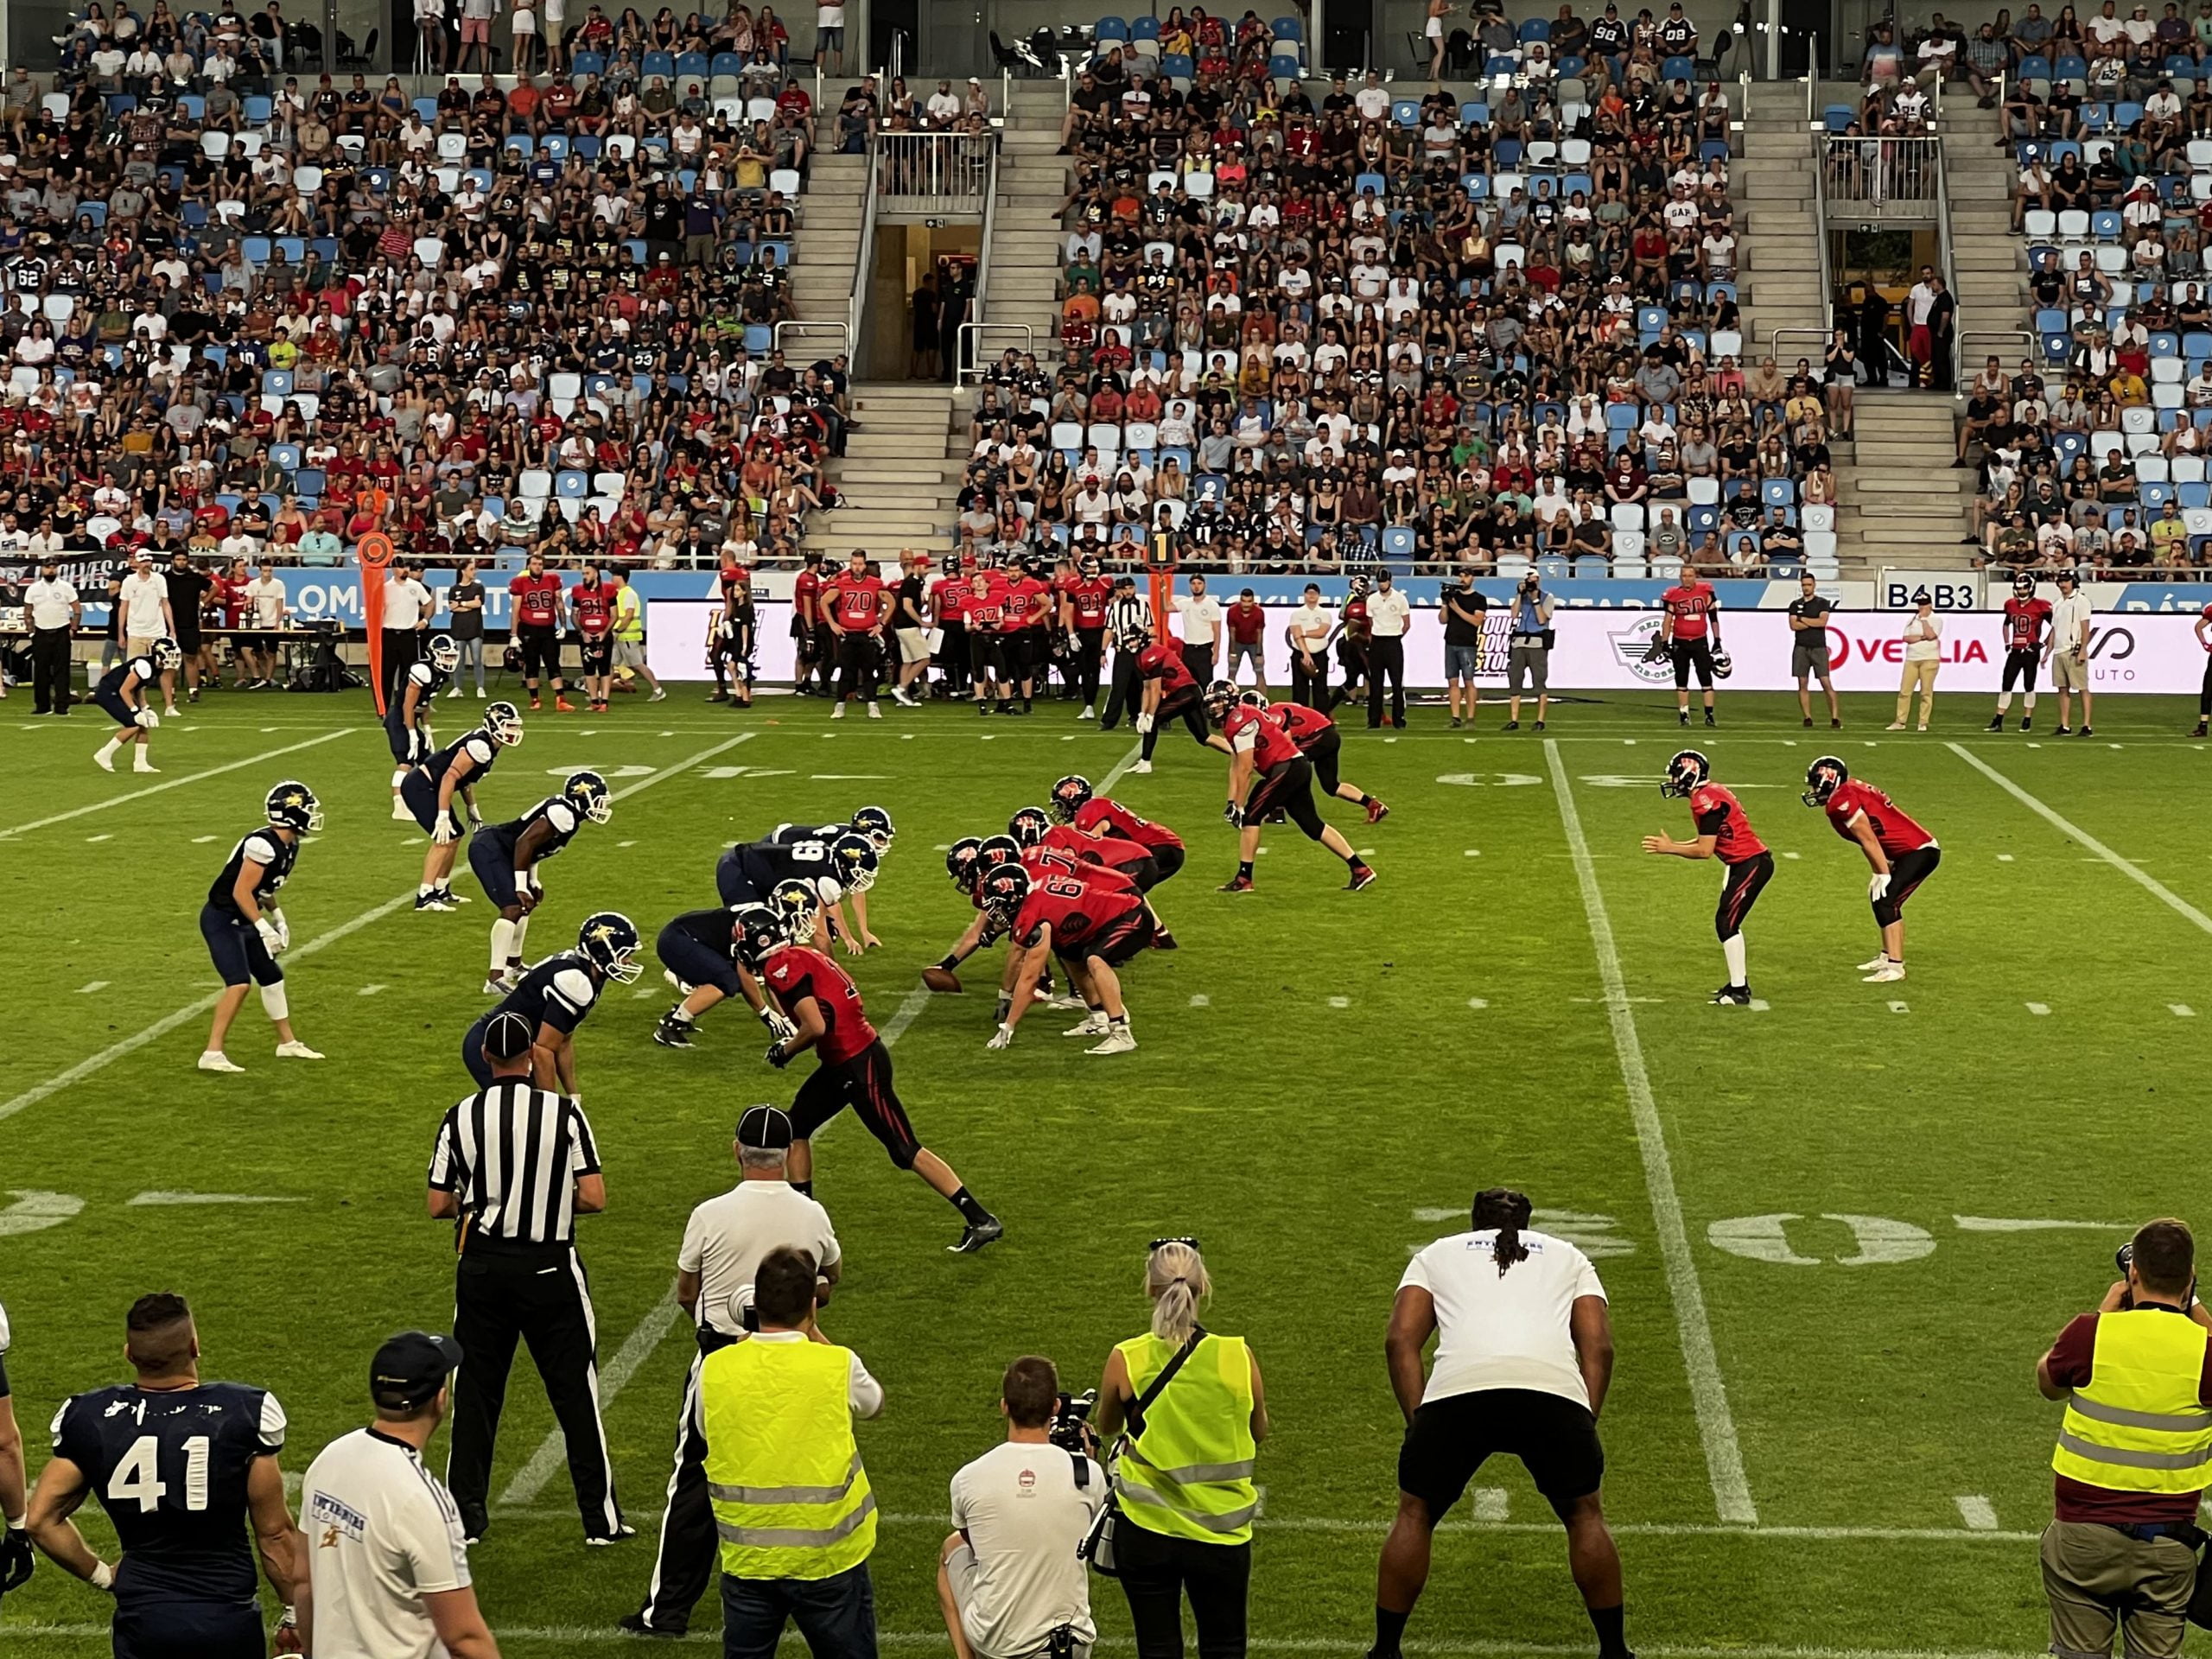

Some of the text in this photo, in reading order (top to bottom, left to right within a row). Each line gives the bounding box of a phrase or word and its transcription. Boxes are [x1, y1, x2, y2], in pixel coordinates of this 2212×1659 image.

[1594, 26, 1617, 41] 98
[1636, 99, 1644, 111] 7
[1302, 140, 1312, 156] 7
[1157, 208, 1166, 223] 5
[18, 269, 38, 287] 62
[634, 354, 653, 366] 33
[1195, 525, 1211, 545] 11
[1154, 532, 1167, 562] 1
[525, 588, 554, 611] 66
[844, 591, 873, 613] 70
[1078, 592, 1102, 612] 81
[1676, 596, 1707, 615] 50
[1888, 583, 1974, 609] B4B3
[1857, 639, 1988, 664] VEIA
[2094, 670, 2135, 681] UTO
[107, 1435, 210, 1513] 41
